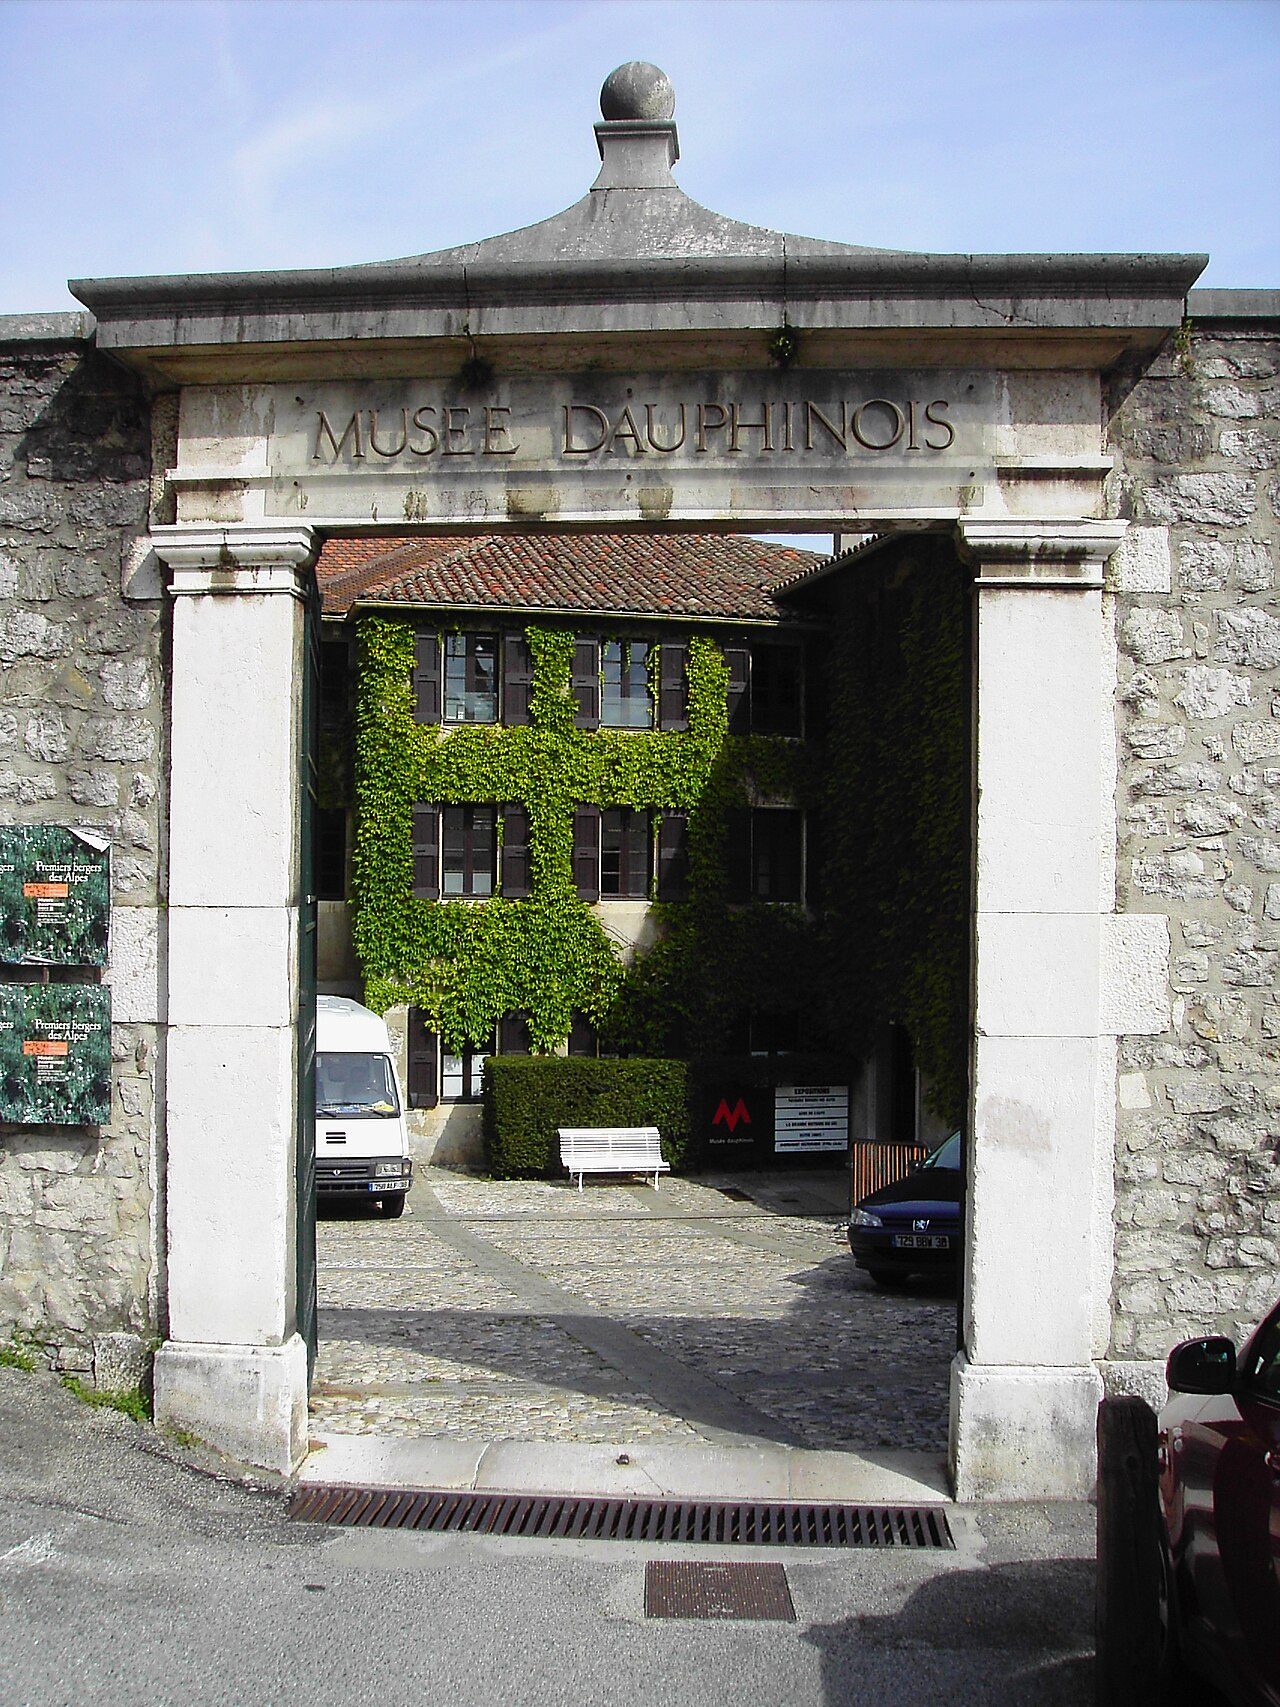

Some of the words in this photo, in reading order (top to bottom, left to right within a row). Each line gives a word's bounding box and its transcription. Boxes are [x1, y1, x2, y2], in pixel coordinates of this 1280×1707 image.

[313, 406, 521, 459] MUSEE
[562, 399, 957, 456] DAUPHINOIS
[36, 861, 71, 872] Premiers
[73, 862, 103, 875] bergers
[49, 872, 63, 882] des
[65, 872, 89, 885] Alpes
[35, 1019, 70, 1030] Premiers
[72, 1020, 102, 1032] bergers
[48, 1030, 62, 1041] des
[64, 1030, 88, 1043] Alpes
